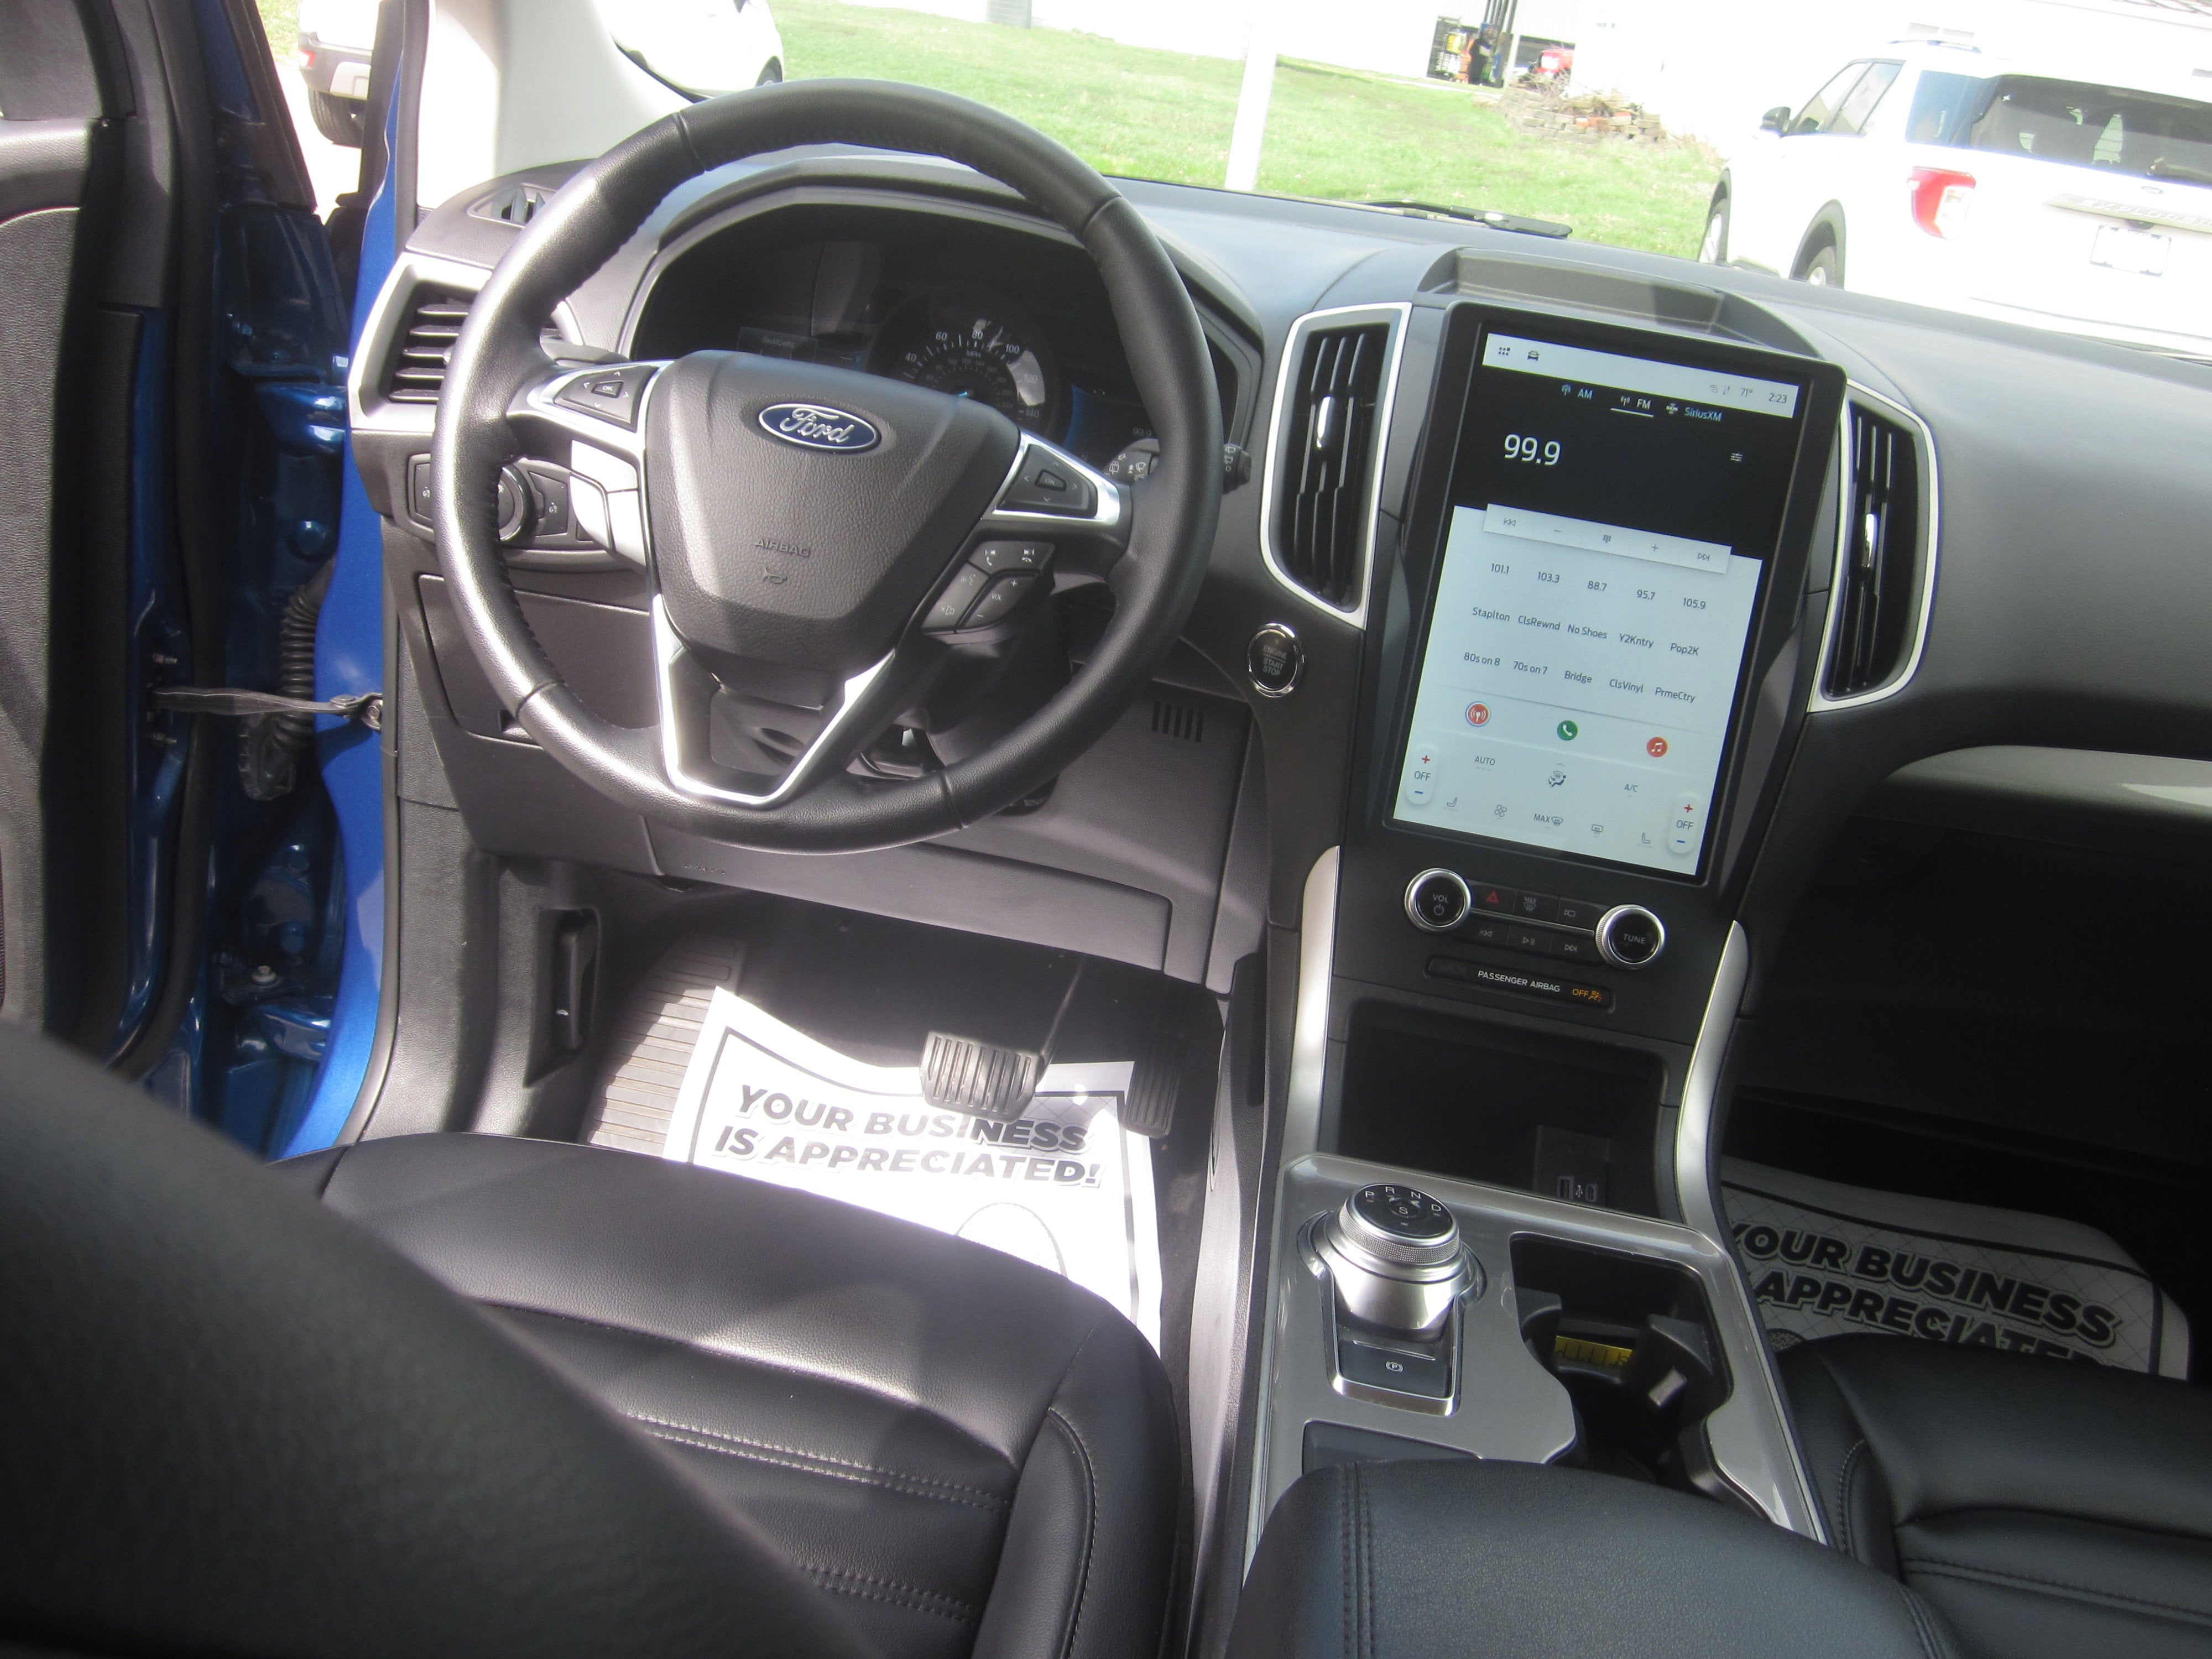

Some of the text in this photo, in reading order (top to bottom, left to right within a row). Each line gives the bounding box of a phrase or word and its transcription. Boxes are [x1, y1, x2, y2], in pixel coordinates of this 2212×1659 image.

[936, 331, 947, 341] 60
[972, 330, 983, 340] 80
[1006, 343, 1020, 354] 100
[905, 352, 917, 362] 40
[1024, 374, 1037, 384] 120
[1578, 389, 1593, 399] AM
[1768, 392, 1787, 404] 2:23
[1636, 398, 1651, 410] FM
[1684, 406, 1722, 422] SiriusXM
[779, 408, 855, 443] Ford
[1504, 433, 1561, 466] 99.9
[1490, 562, 1510, 575] 101.1
[1537, 571, 1560, 583] 103.3
[1588, 581, 1608, 592] 88.7
[1636, 589, 1656, 601] 95.7
[1683, 597, 1706, 609] 105.9
[1517, 615, 1561, 631] ClsRewnd
[1567, 624, 1608, 640] No Shoes
[1619, 633, 1654, 649] Y2Kntry
[1263, 645, 1287, 659] ENGINE
[1670, 642, 1699, 656] Pop2K
[1263, 658, 1284, 671] START
[1464, 652, 1501, 666] 80s on 8
[1262, 666, 1281, 677] STOP
[1513, 661, 1548, 675] 70s on 7
[1564, 670, 1593, 684] Bridge
[1609, 679, 1645, 693] ClsVinyl
[1655, 686, 1696, 703] PrmeCtry
[1474, 755, 1495, 766] AUTO
[1413, 770, 1432, 781] OFF
[1624, 783, 1639, 793] A/C
[1533, 813, 1551, 823] MAX
[1676, 819, 1694, 831] OFF
[1432, 893, 1449, 904] VOL
[1623, 933, 1647, 945] TUNE
[1478, 969, 1589, 998] PASSENGER AIRBAG OFF
[740, 1084, 1089, 1152] YOUR BUSINESS
[714, 1126, 1100, 1188] IS APPRECIATED!
[1411, 1191, 1421, 1199] N
[1855, 1244, 2116, 1343] BUSINESS
